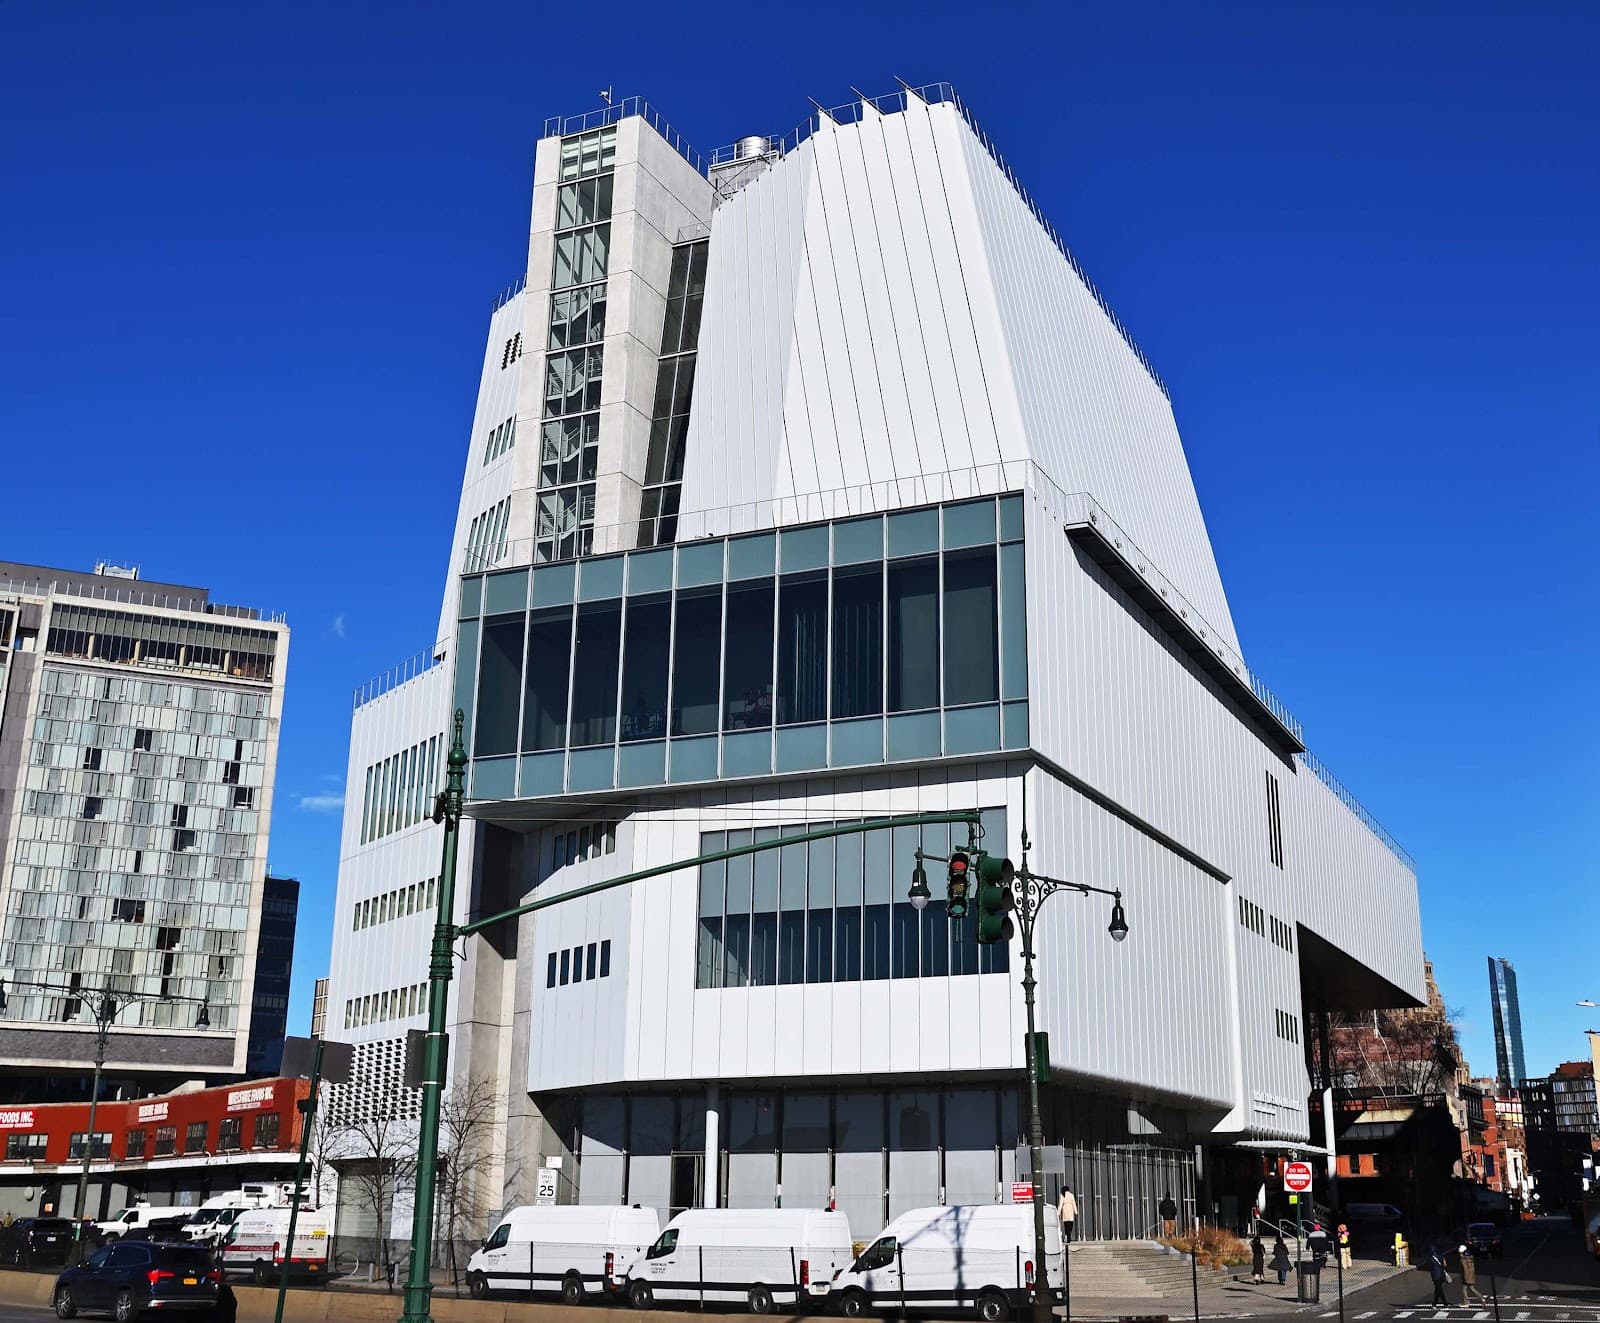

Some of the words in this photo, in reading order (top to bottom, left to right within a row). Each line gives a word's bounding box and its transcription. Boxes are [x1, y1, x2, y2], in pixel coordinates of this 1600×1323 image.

[0, 1111, 20, 1124] FOODS
[20, 1110, 34, 1123] INC.
[539, 1185, 553, 1196] 25
